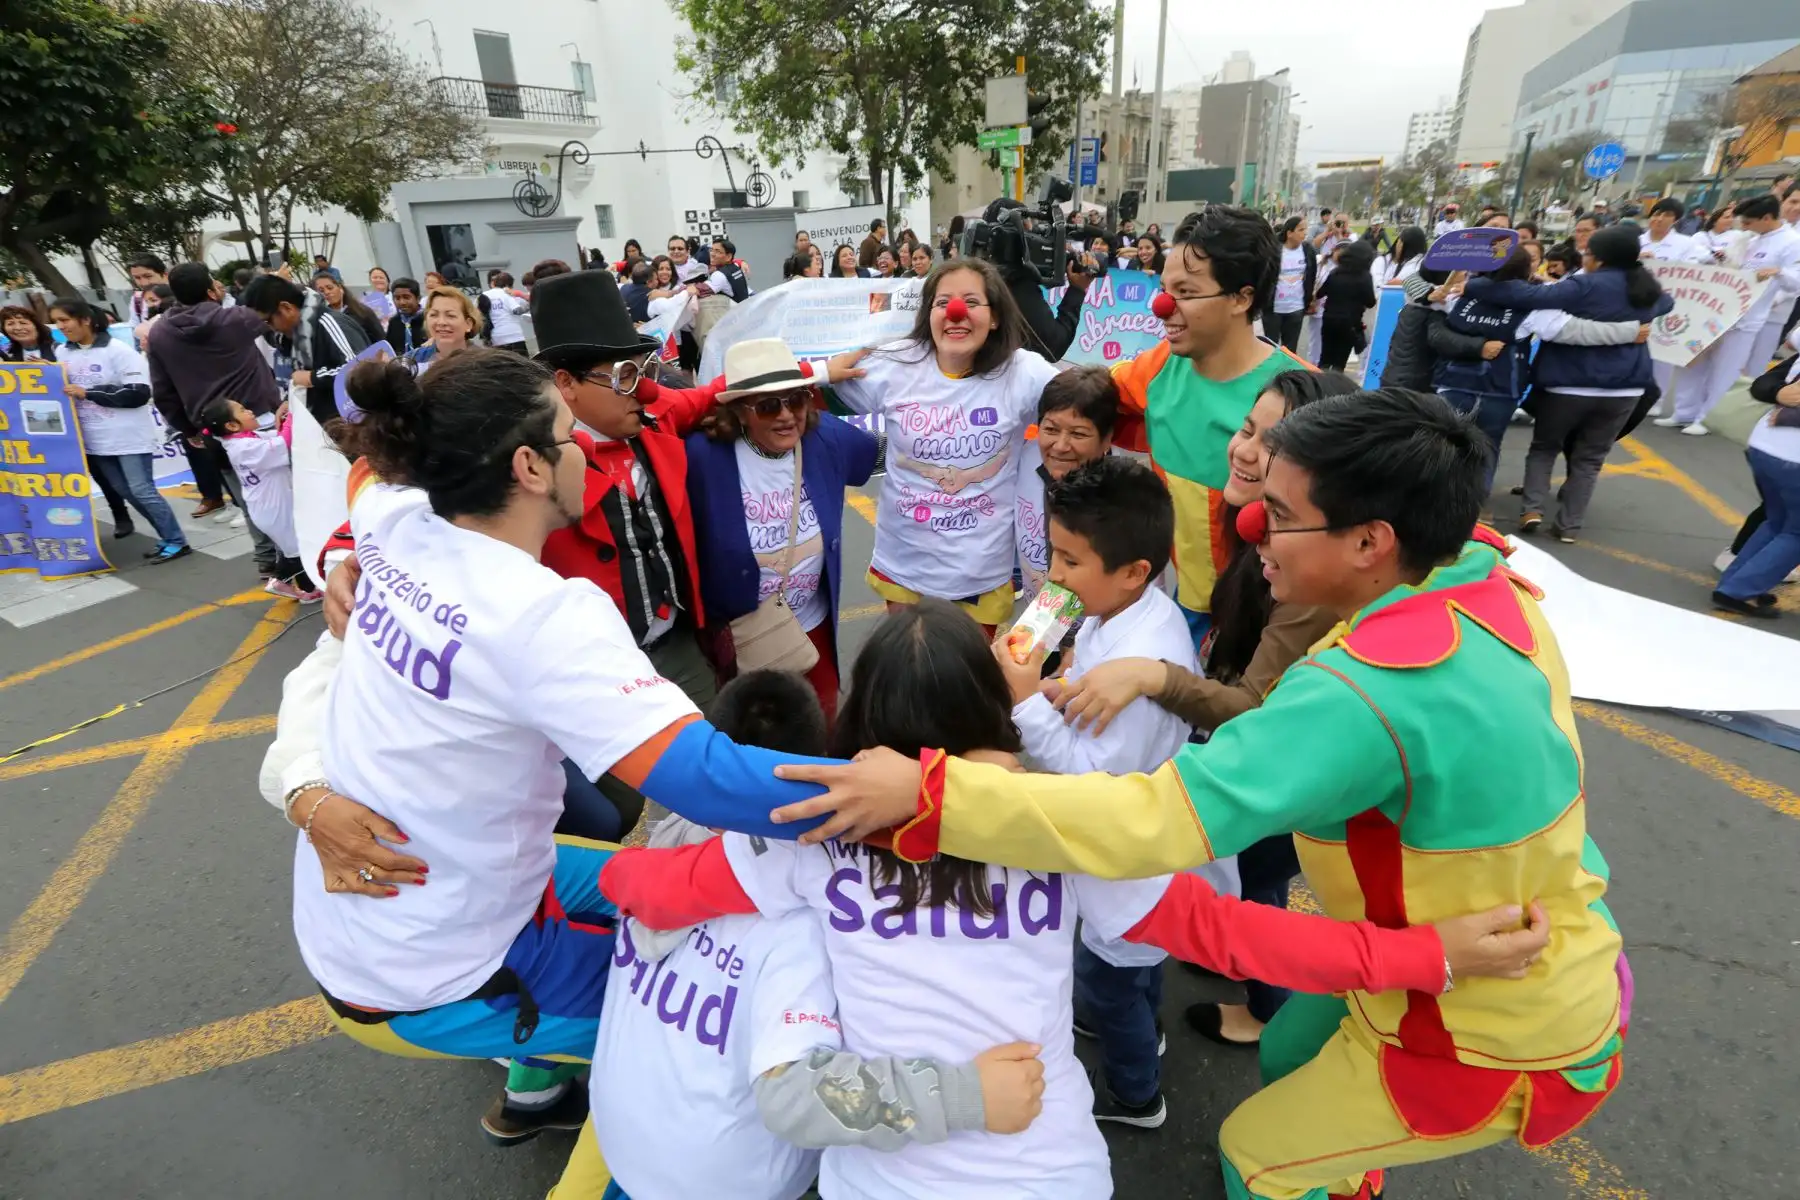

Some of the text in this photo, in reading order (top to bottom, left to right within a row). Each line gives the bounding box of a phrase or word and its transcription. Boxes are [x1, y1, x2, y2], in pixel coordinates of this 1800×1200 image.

[498, 161, 538, 170] LIBRERIA
[811, 223, 872, 239] BIENVENIDO
[1657, 266, 1705, 283] PITAL
[1124, 285, 1139, 300] MI
[1662, 287, 1726, 315] NTRAL
[1080, 310, 1168, 352] abrace
[896, 402, 968, 436] TOMA
[977, 409, 992, 424] MI
[913, 430, 1002, 461] mano
[742, 486, 794, 523] OMA
[931, 507, 979, 532] vida
[434, 603, 468, 635] de
[715, 943, 745, 980] de
